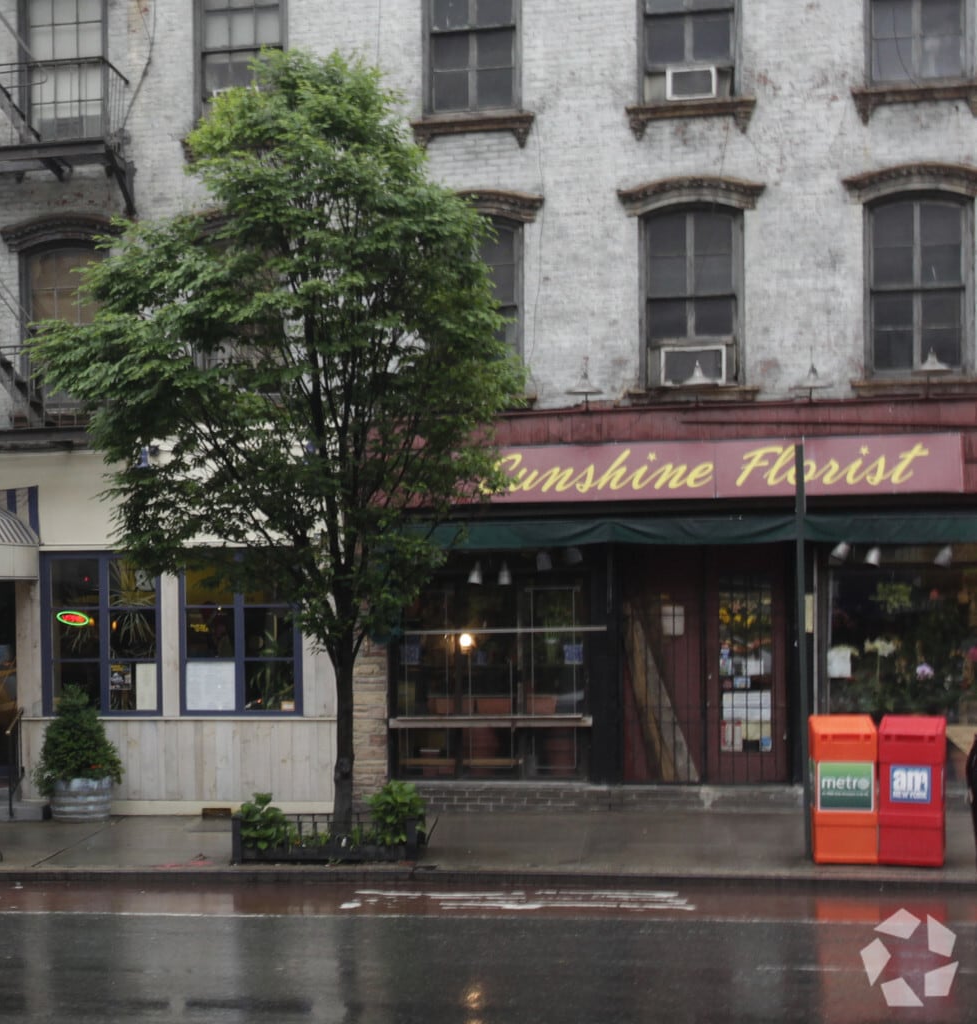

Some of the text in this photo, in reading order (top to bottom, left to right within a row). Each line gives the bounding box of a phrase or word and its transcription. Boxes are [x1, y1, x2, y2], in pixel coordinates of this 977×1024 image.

[479, 441, 929, 494] Sunshine Florist
[822, 774, 870, 790] metro
